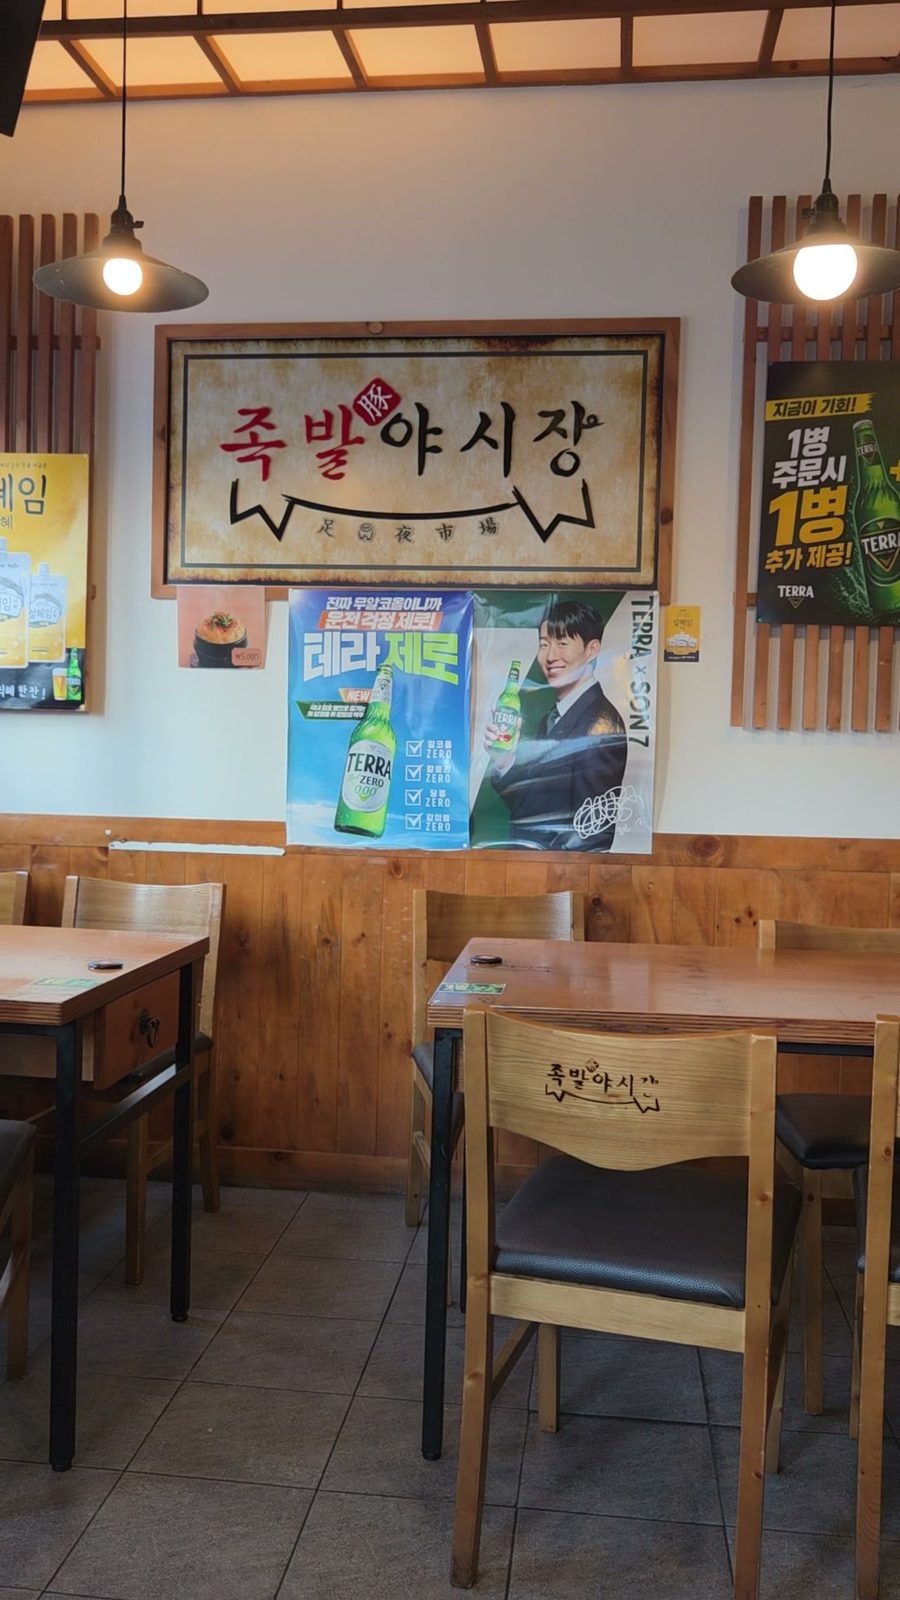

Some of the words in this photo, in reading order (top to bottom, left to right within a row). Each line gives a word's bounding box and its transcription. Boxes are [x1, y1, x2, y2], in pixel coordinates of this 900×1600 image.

[773, 400, 817, 417] 지금이
[820, 397, 857, 413] 기회!
[788, 426, 830, 459] 1병
[772, 455, 847, 489] 주문시
[769, 485, 848, 546] 1병
[861, 531, 900, 555] TERR
[765, 547, 803, 573] 추가
[806, 542, 853, 568] 제공!
[777, 585, 814, 598] TERRA
[326, 597, 352, 610] 진짜
[353, 597, 442, 611] 무알코올이니까
[325, 611, 361, 630] 운전
[359, 611, 397, 630] 걱정
[393, 611, 437, 630] 제로!
[630, 596, 654, 660] TERRA
[304, 631, 380, 682] 테라
[382, 631, 459, 685] 제로
[347, 690, 371, 701] NEW
[426, 749, 452, 759] ZERO
[347, 753, 391, 780] TERRA
[360, 775, 384, 788] ZERO
[425, 773, 451, 783] ZERO
[425, 798, 451, 807] ZERO
[425, 822, 451, 832] ZERO
